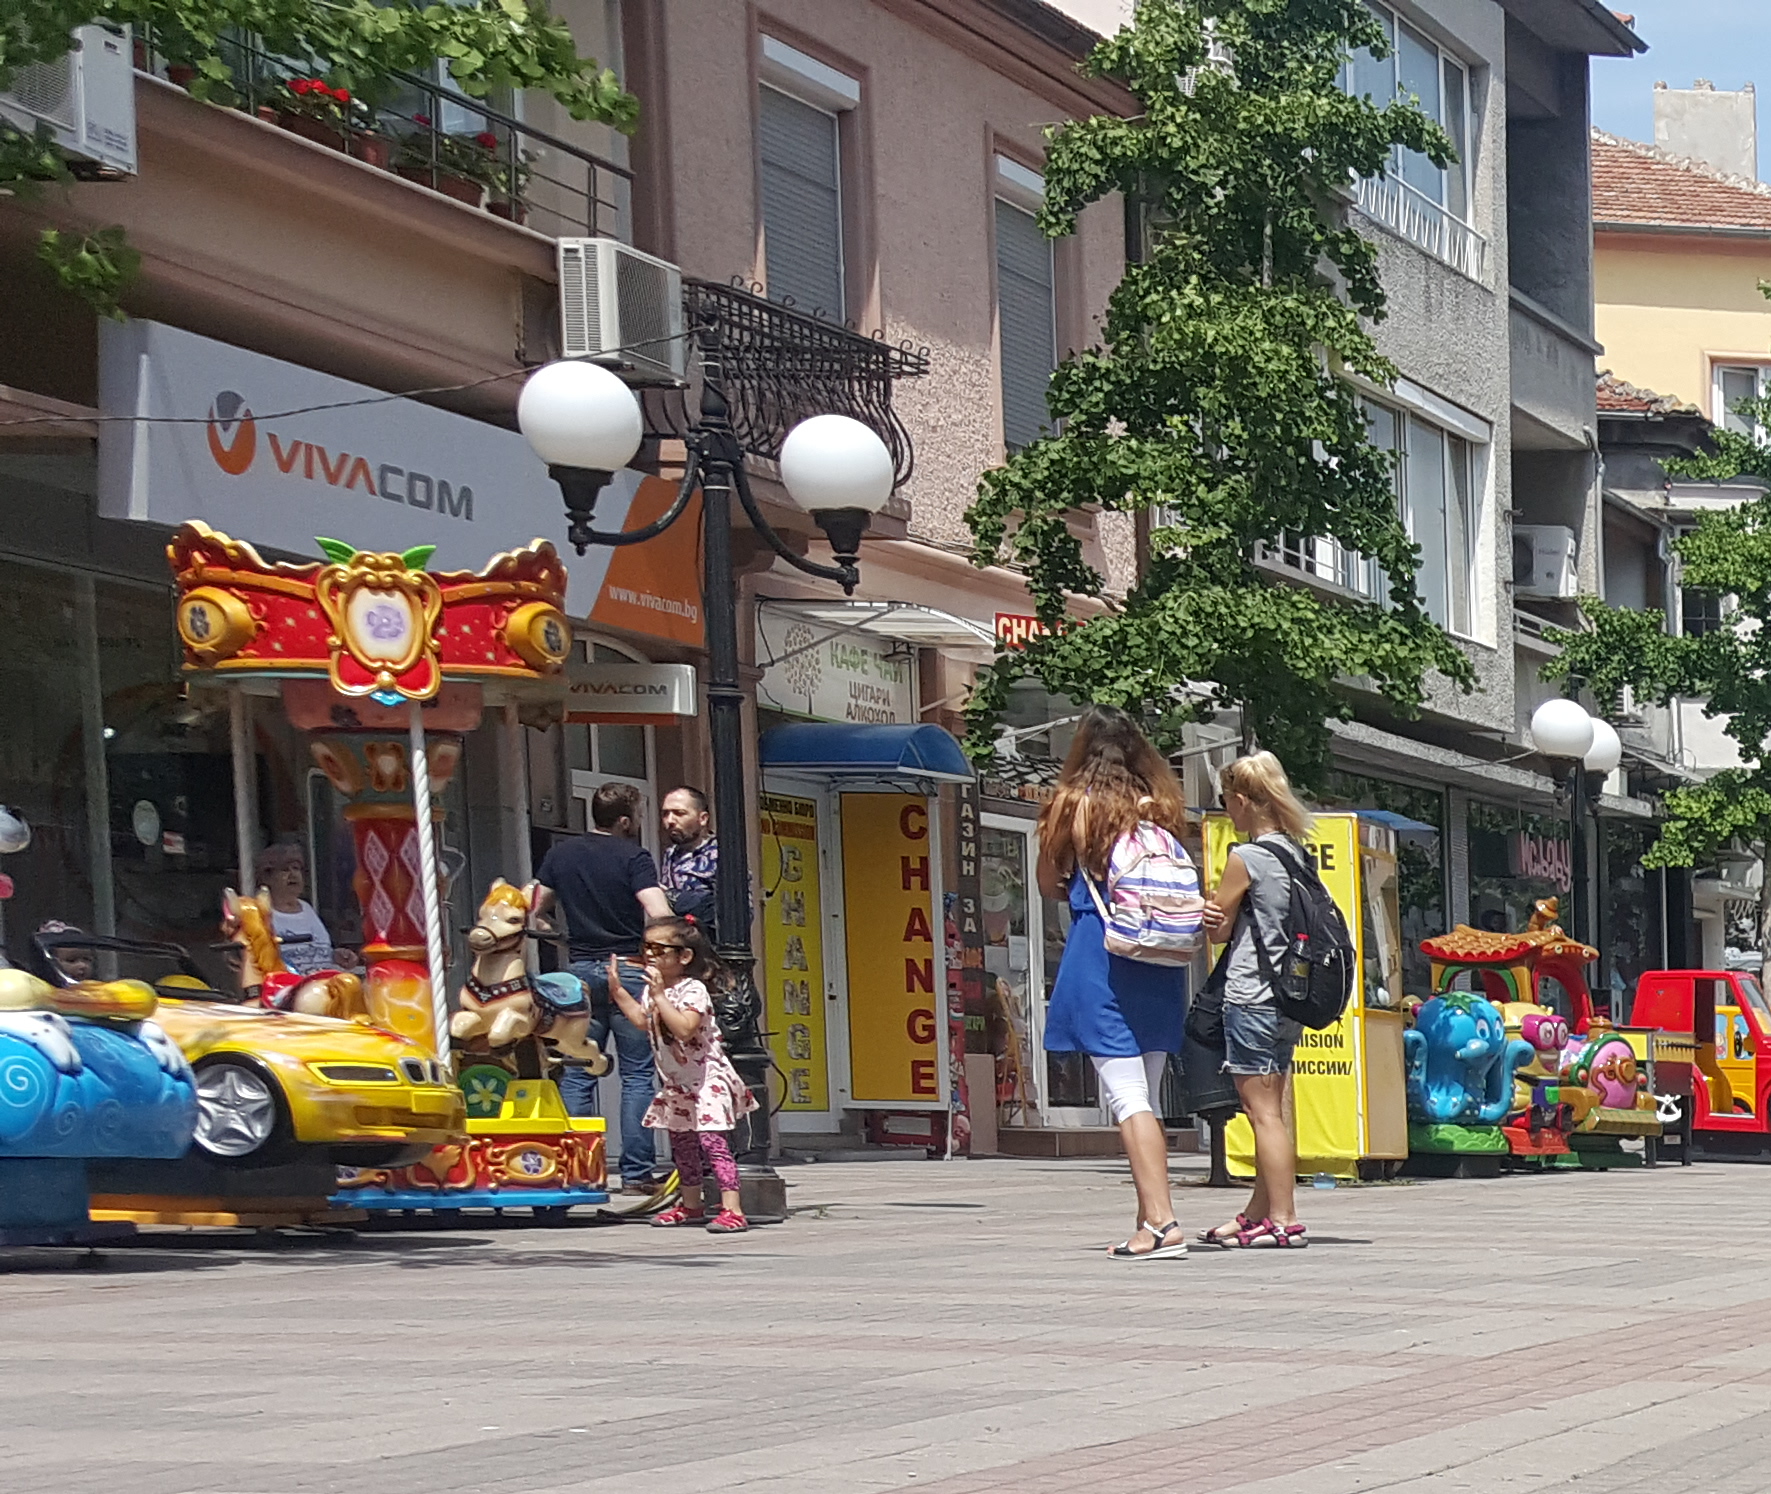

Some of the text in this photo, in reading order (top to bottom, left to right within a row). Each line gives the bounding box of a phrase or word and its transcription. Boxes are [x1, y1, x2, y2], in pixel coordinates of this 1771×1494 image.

[267, 432, 474, 522] VIVACOM
[609, 586, 698, 624] www.vivacom.bg
[830, 640, 868, 676] КАФЕ
[570, 682, 668, 696] VIVACOM
[849, 680, 891, 707] ЦИГАРИ
[900, 804, 937, 1095] CHANGE
[781, 844, 812, 1104] CHANGE
